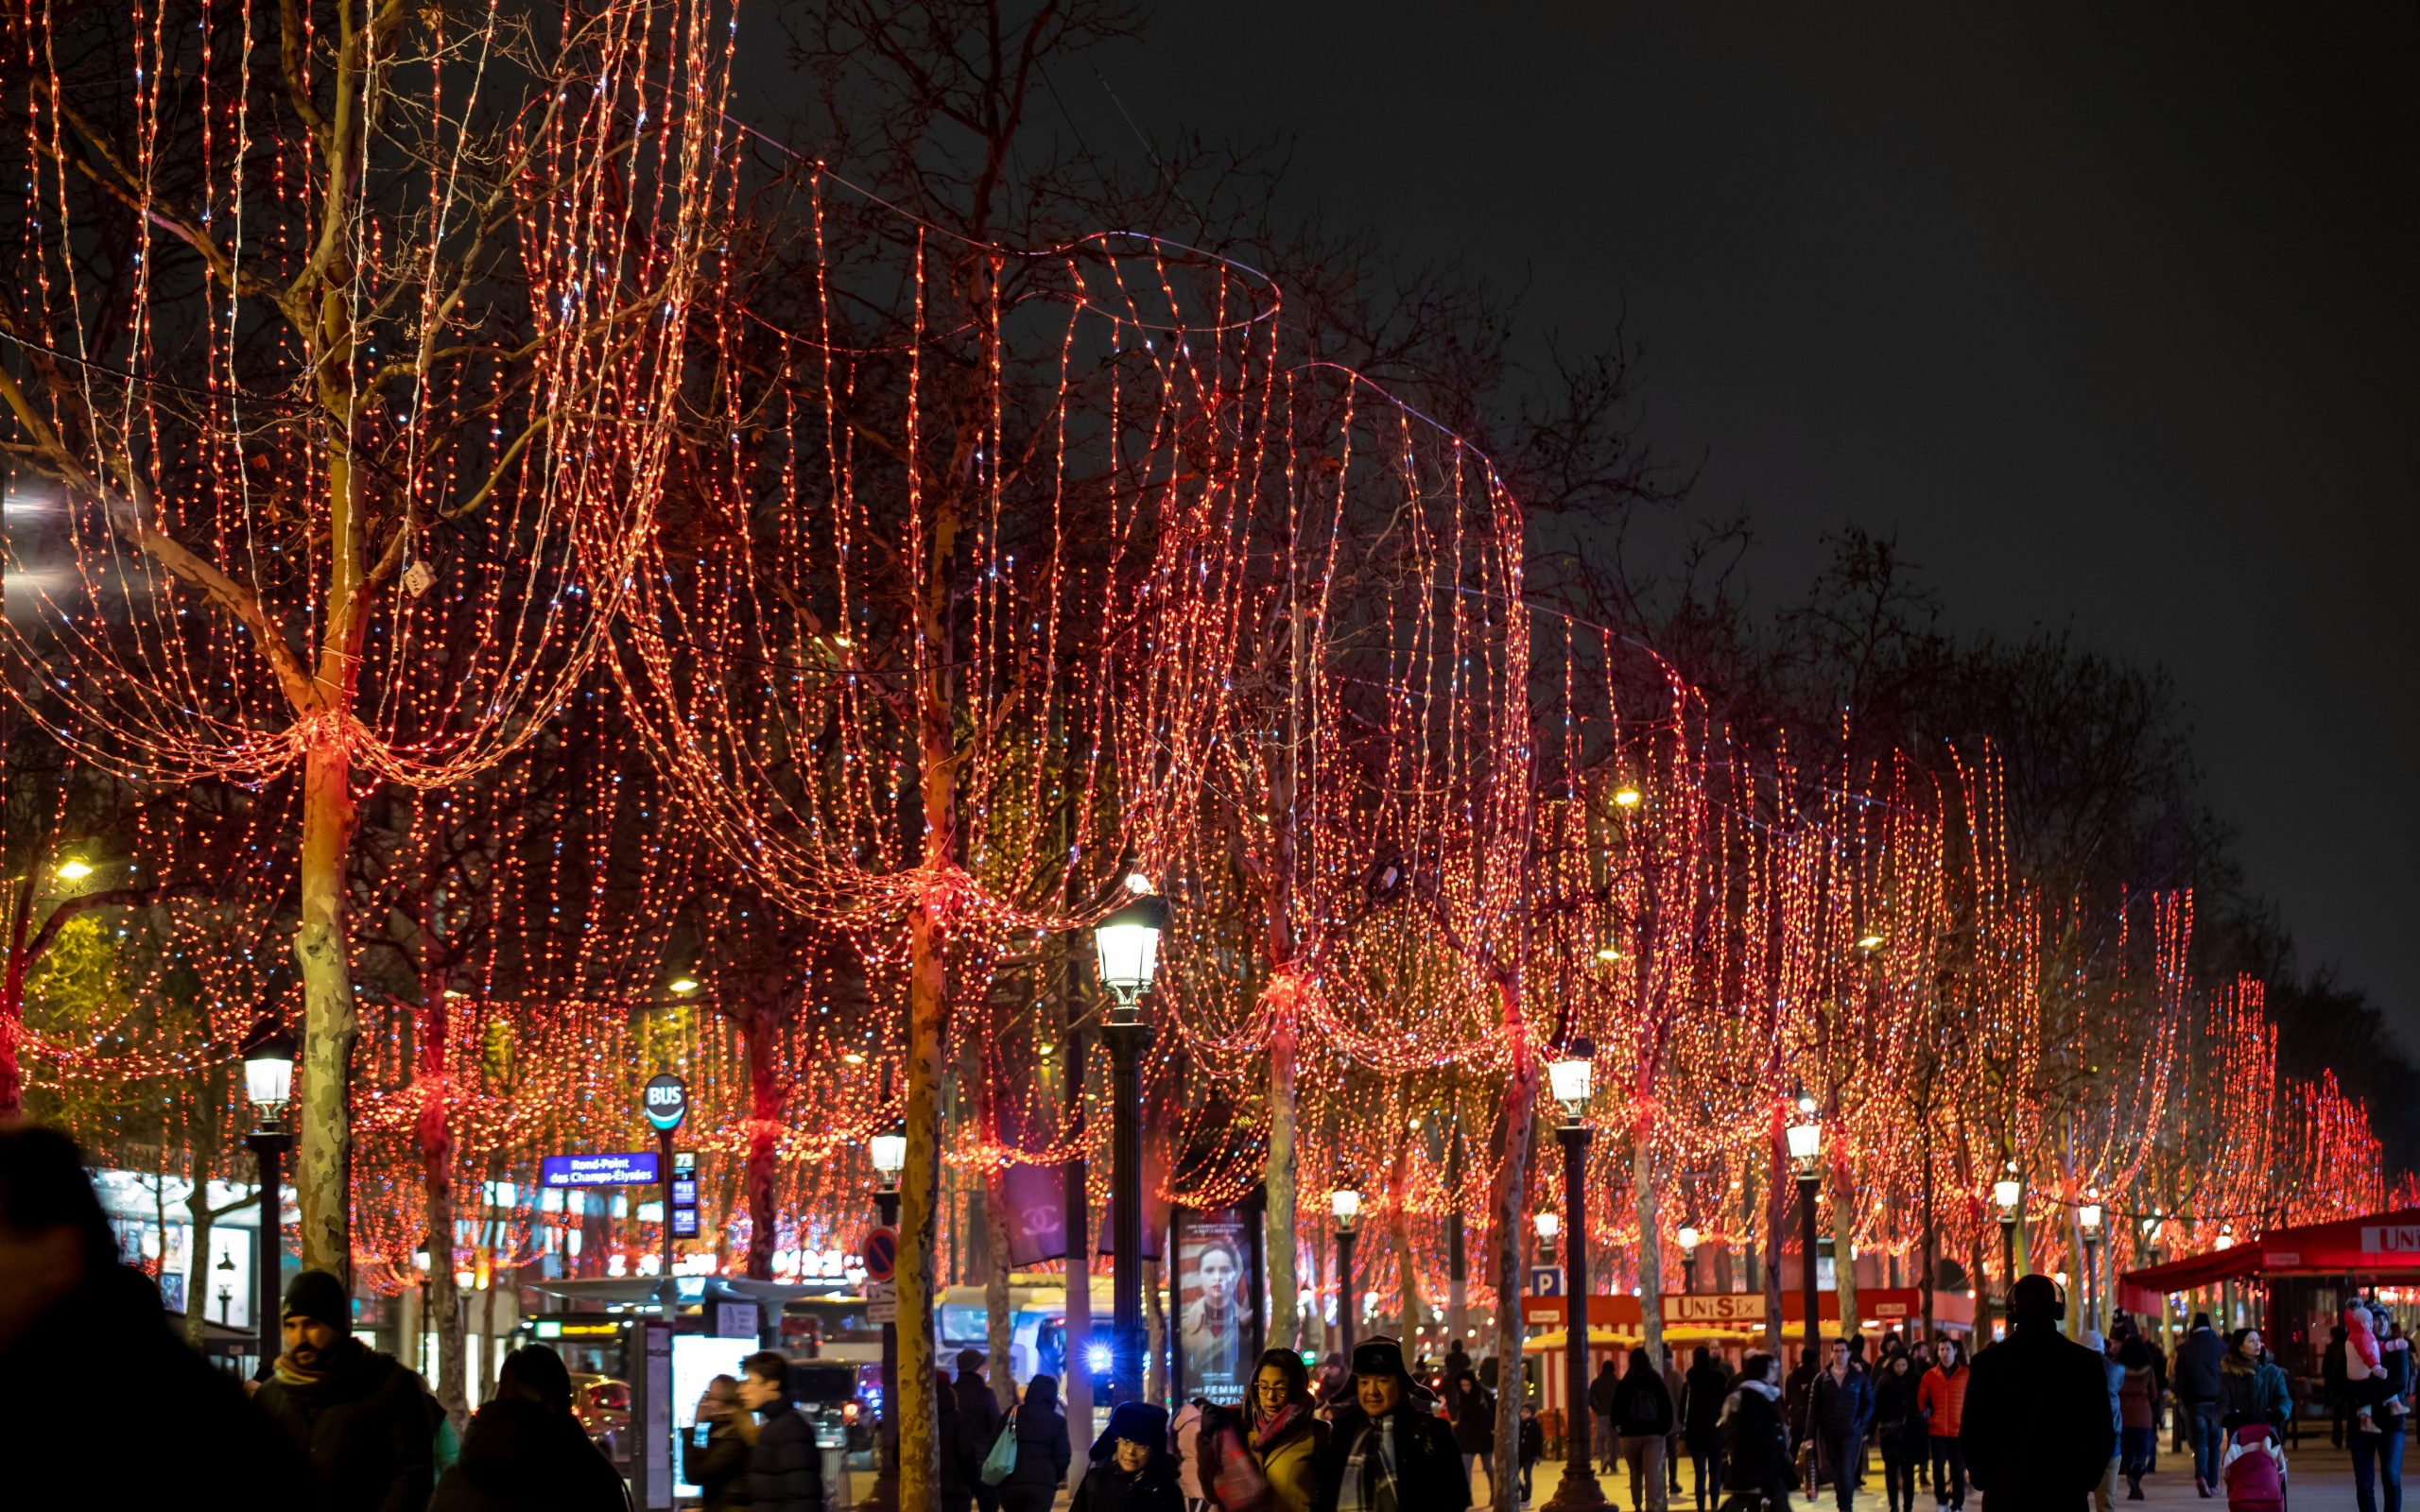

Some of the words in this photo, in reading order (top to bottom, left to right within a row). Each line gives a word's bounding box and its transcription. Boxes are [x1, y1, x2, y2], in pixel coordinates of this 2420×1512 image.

[648, 1086, 682, 1106] BUS
[571, 1158, 630, 1171] Rond-Point
[675, 1154, 693, 1167] 73
[549, 1172, 569, 1184] des
[570, 1168, 652, 1184] Champs-Élysées
[1539, 1273, 1553, 1297] P
[1203, 1384, 1245, 1394] FEMME
